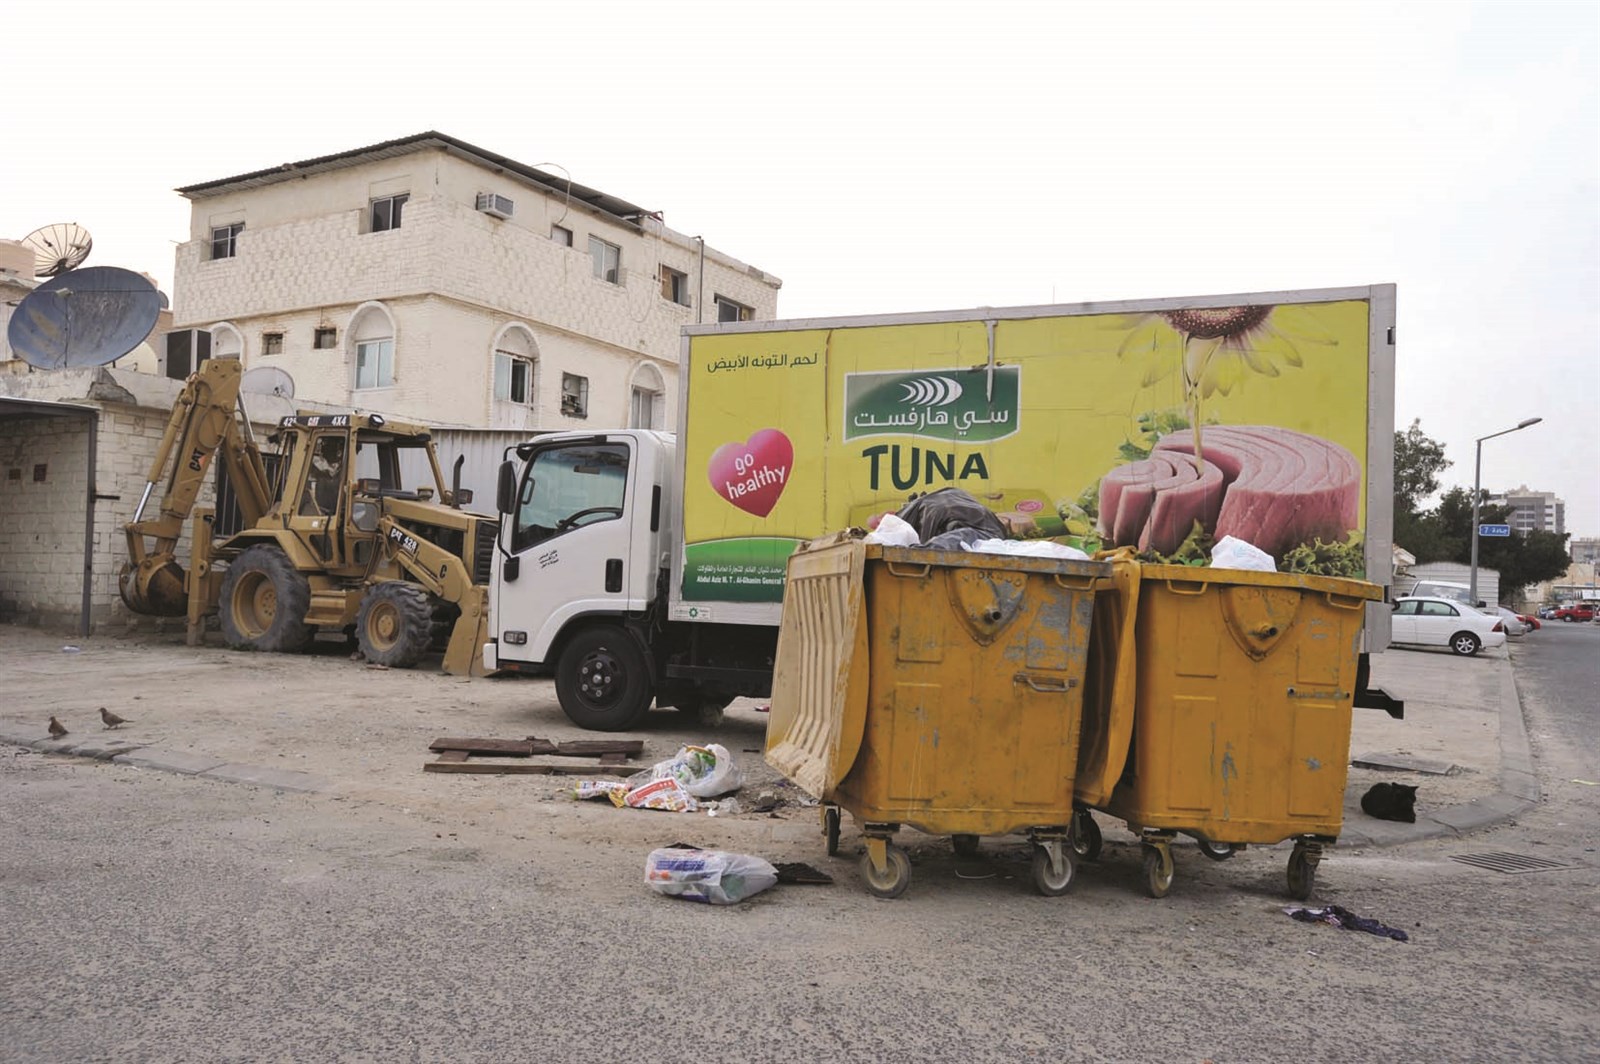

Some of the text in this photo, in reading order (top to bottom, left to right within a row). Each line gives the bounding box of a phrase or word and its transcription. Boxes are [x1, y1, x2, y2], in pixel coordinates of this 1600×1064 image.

[707, 355, 749, 374] الأبيض
[789, 352, 818, 369] لحم
[854, 406, 1009, 436] سي هارفست
[188, 447, 206, 472] CAT
[735, 453, 754, 476] go
[862, 444, 989, 491] TUNA
[726, 465, 785, 499] healthy
